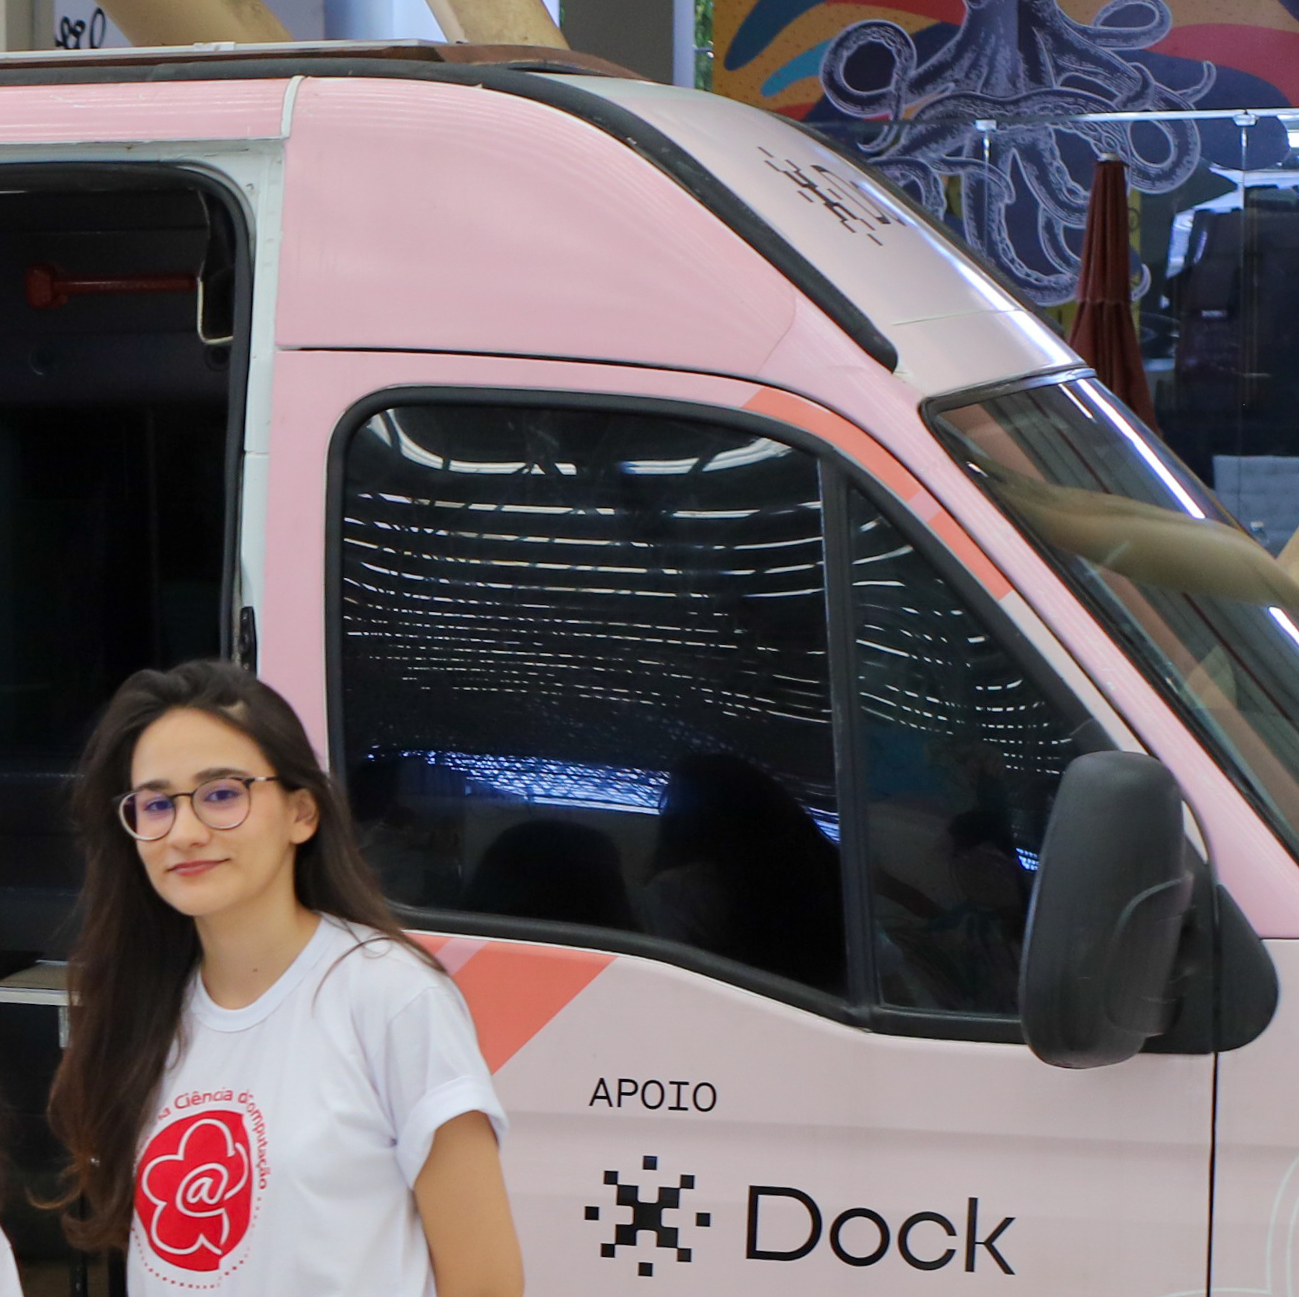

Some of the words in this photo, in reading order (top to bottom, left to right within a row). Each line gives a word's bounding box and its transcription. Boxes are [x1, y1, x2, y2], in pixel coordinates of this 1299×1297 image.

[174, 1087, 234, 1110] Ciência
[245, 1101, 271, 1190] omputação
[589, 1077, 718, 1112] APOIO
[745, 1184, 1017, 1276] Dock
